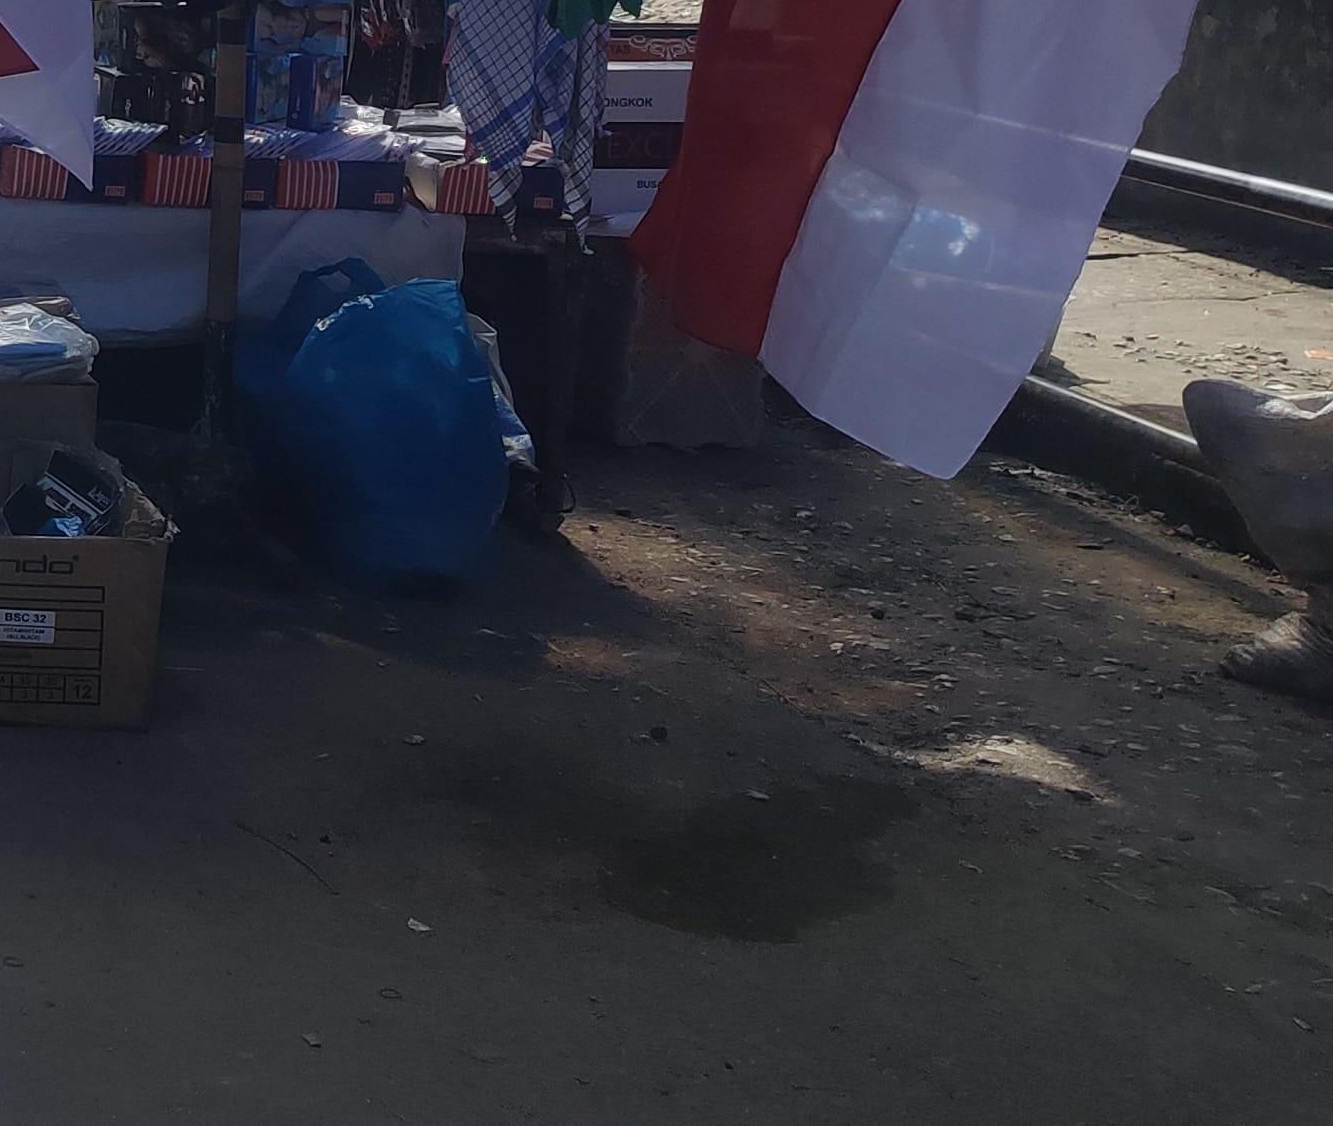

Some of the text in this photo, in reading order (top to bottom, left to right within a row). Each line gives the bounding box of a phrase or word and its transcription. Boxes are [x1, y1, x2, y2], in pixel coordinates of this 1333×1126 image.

[603, 97, 653, 108] ONGKOK
[4, 612, 47, 623] BSC 32
[74, 684, 93, 699] 12
